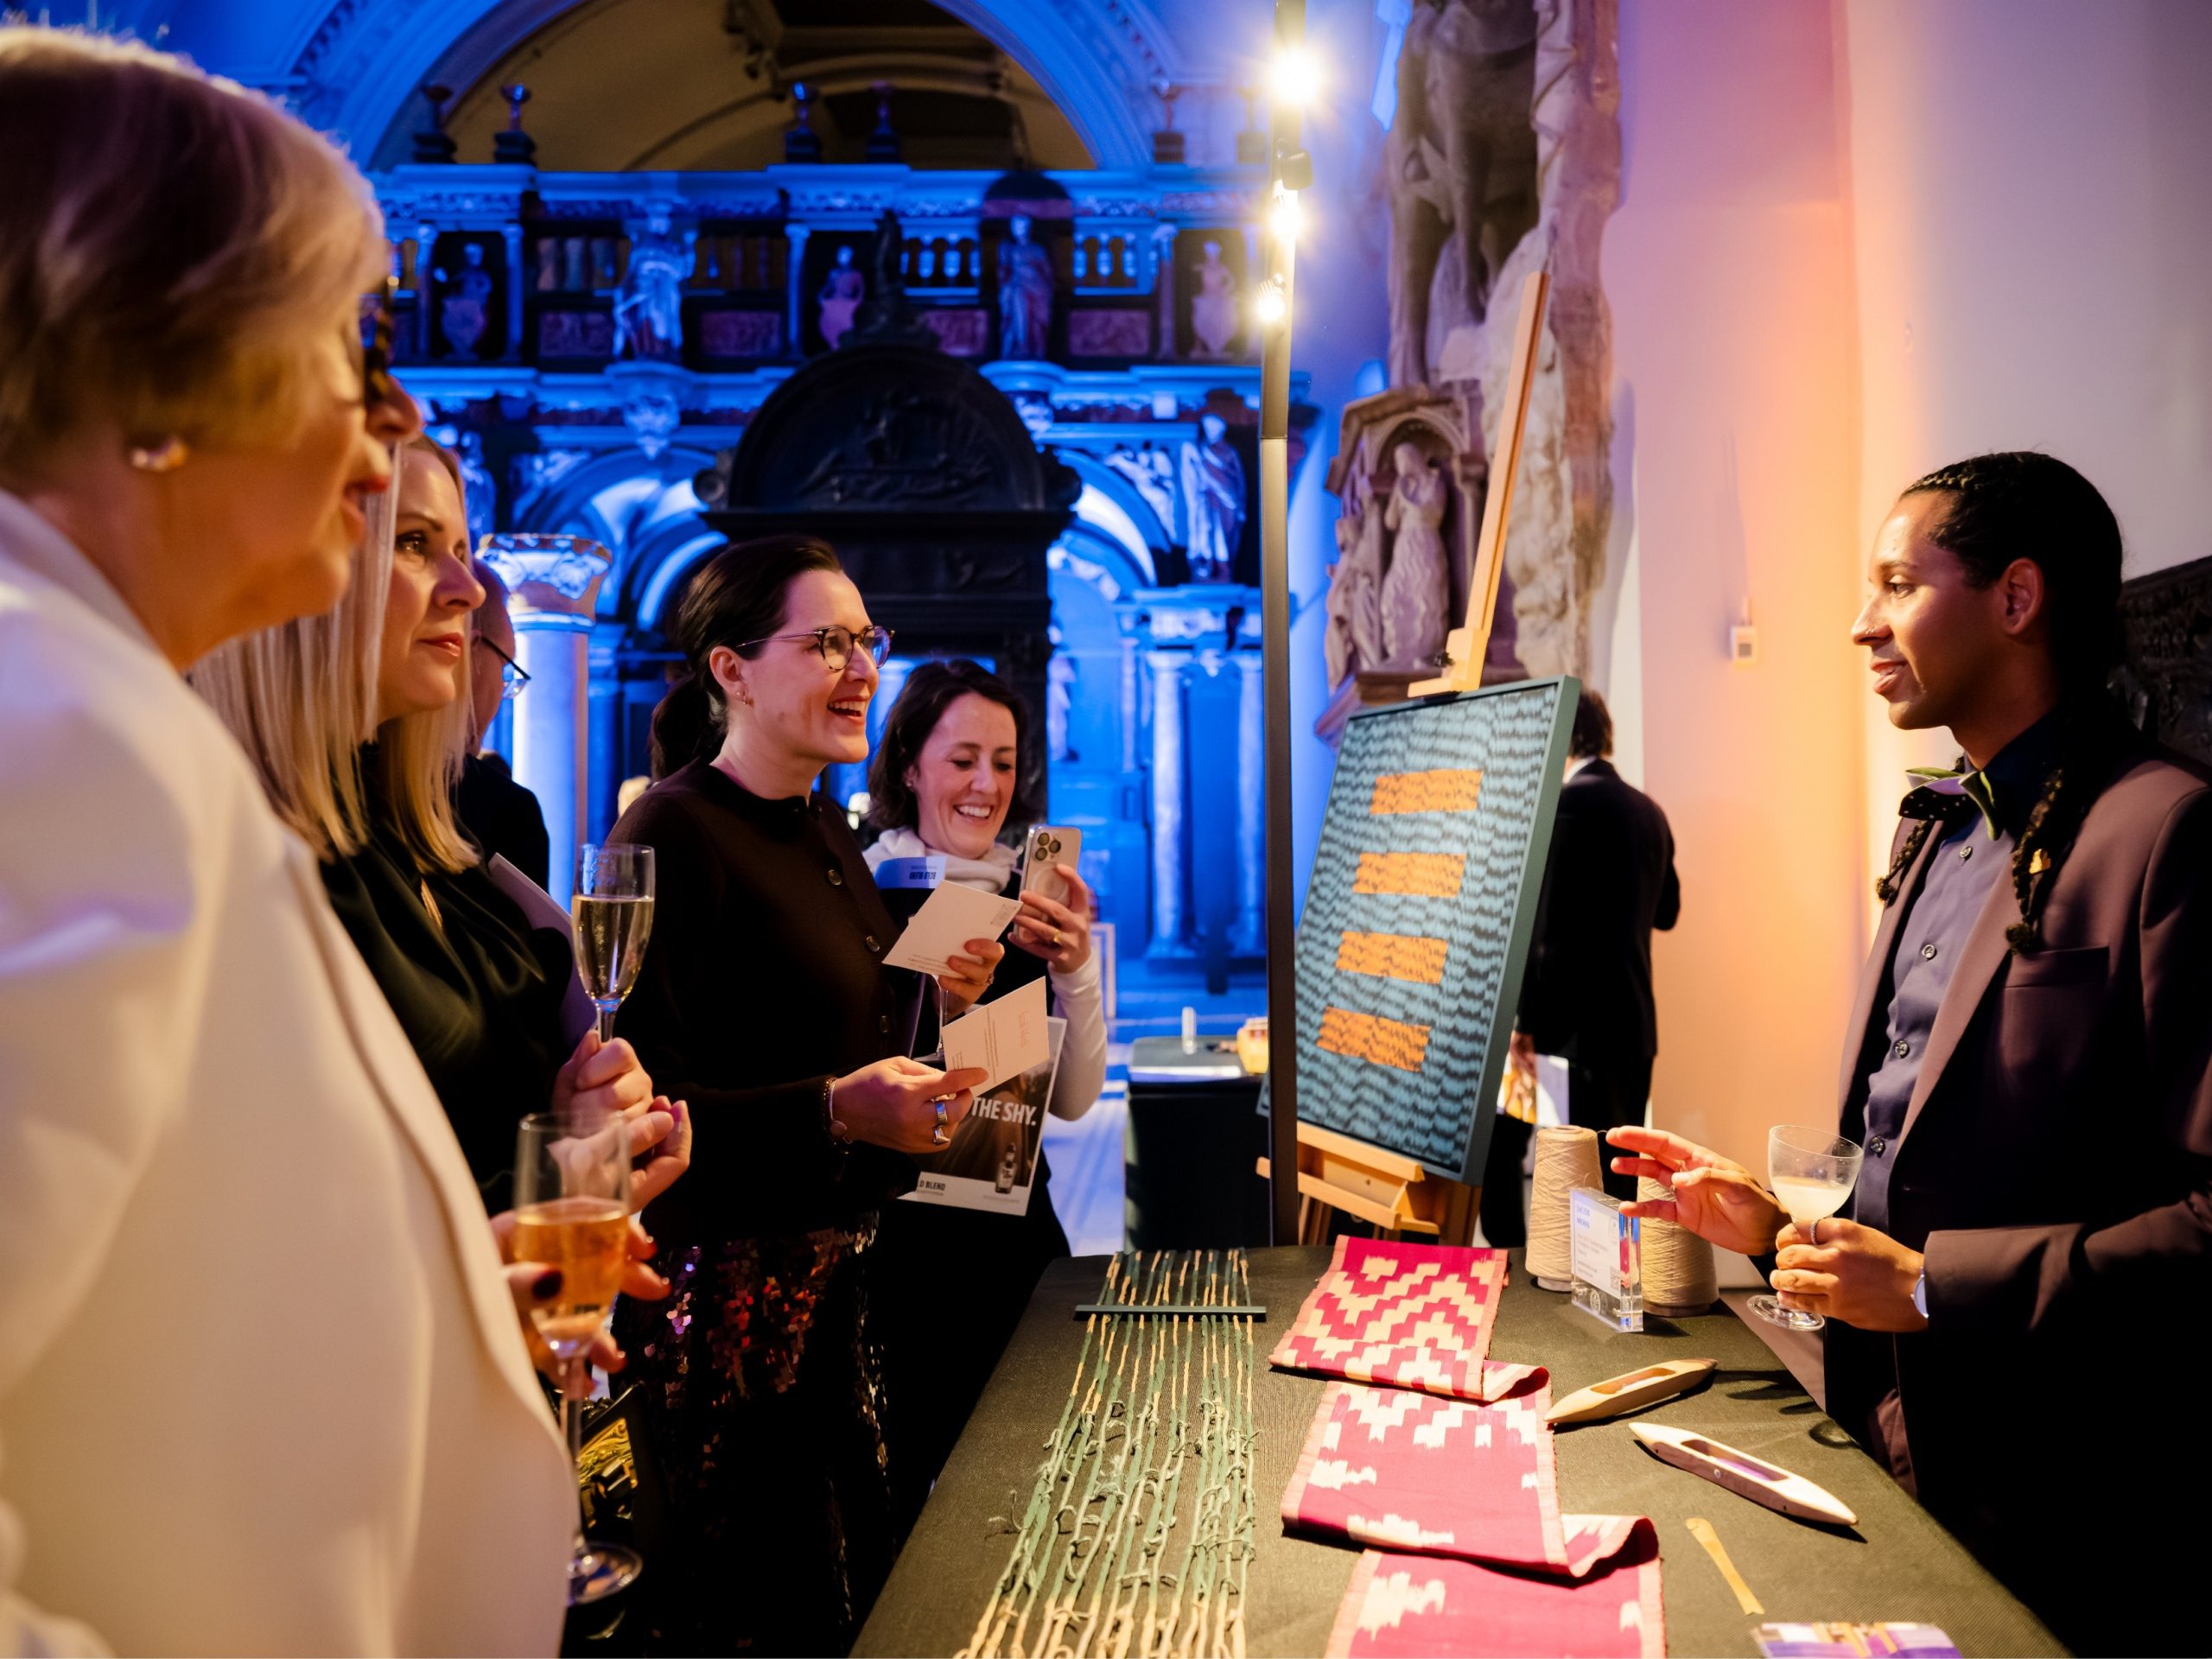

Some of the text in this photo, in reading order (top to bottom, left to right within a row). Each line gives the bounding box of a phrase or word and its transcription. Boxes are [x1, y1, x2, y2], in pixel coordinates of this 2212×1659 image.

[971, 1096, 1037, 1127] THE SHY.
[925, 1180, 946, 1191] BLEND
